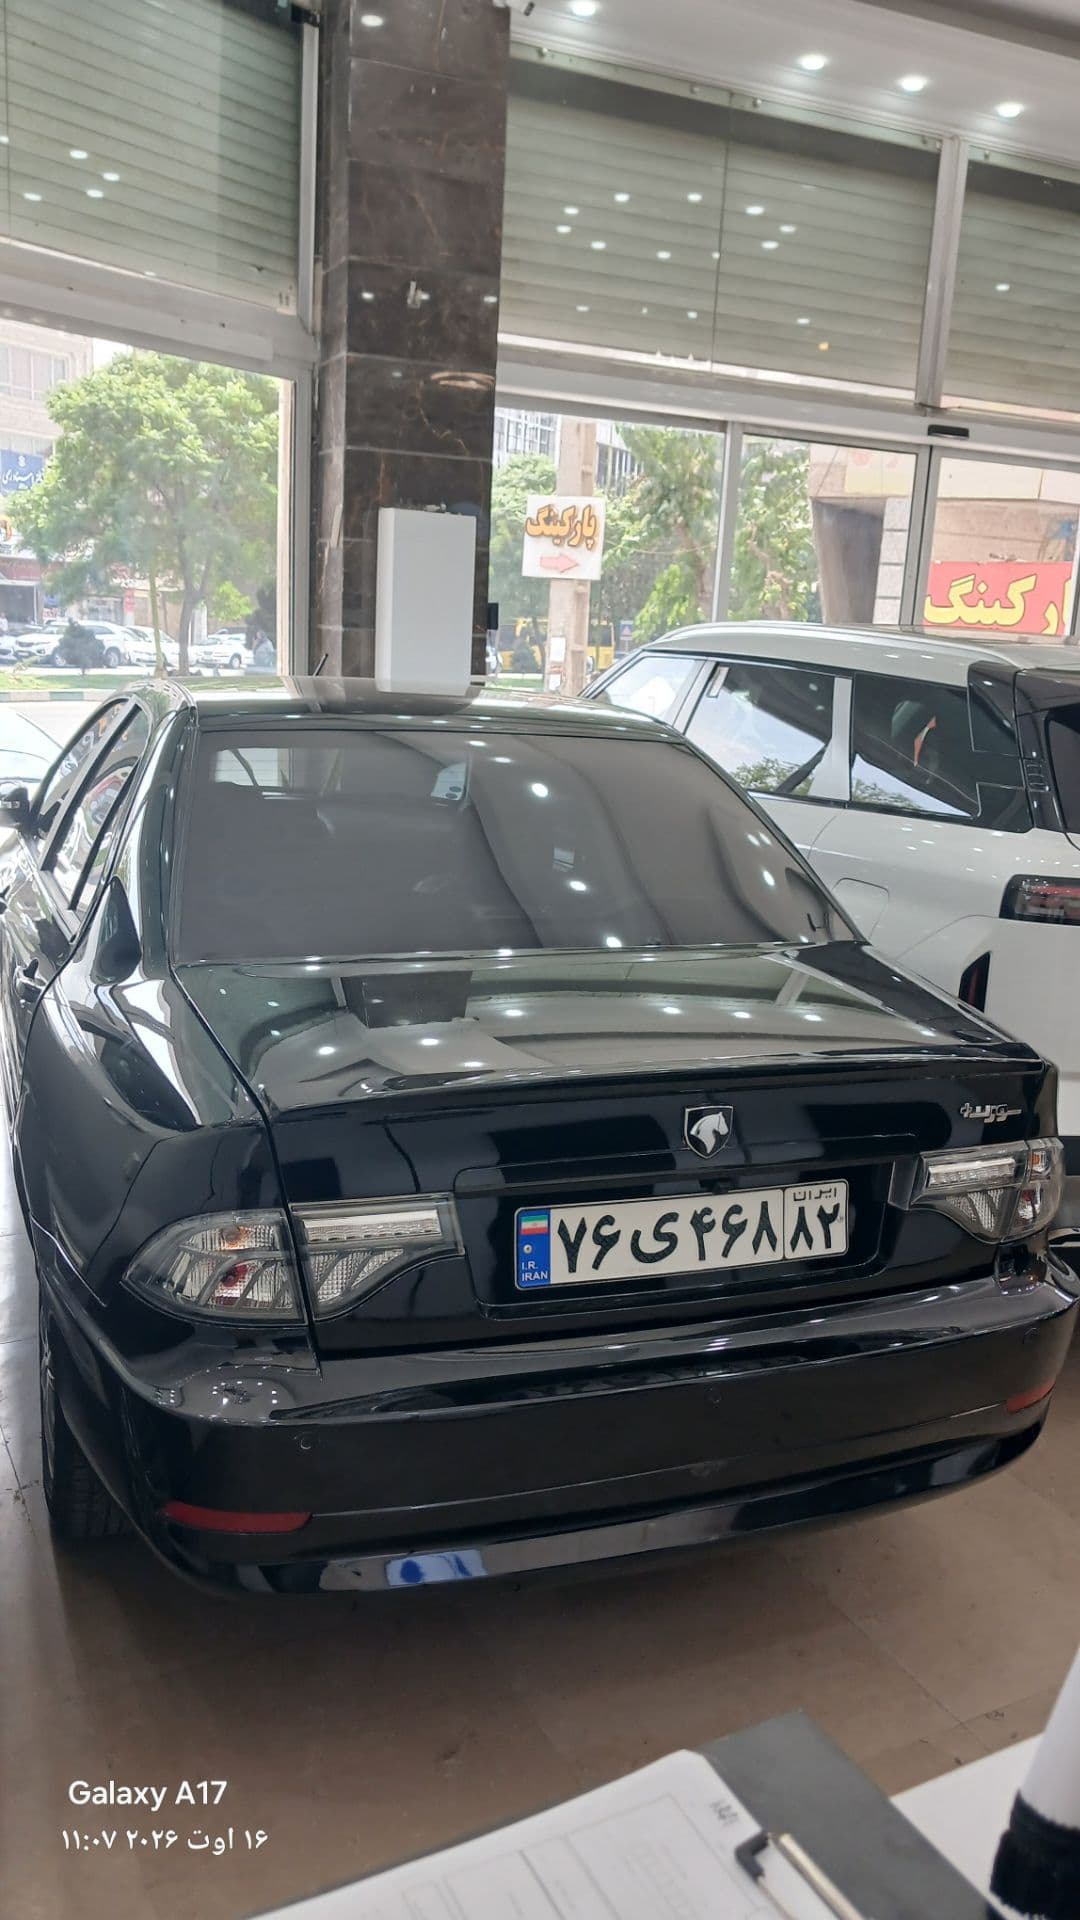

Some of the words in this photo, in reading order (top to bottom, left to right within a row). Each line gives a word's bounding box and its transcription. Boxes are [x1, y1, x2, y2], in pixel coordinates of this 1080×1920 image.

[526, 504, 597, 551] پارکینگ
[793, 1187, 837, 1201] ایران
[521, 1260, 538, 1270] I.R.
[521, 1270, 548, 1281] IRAN
